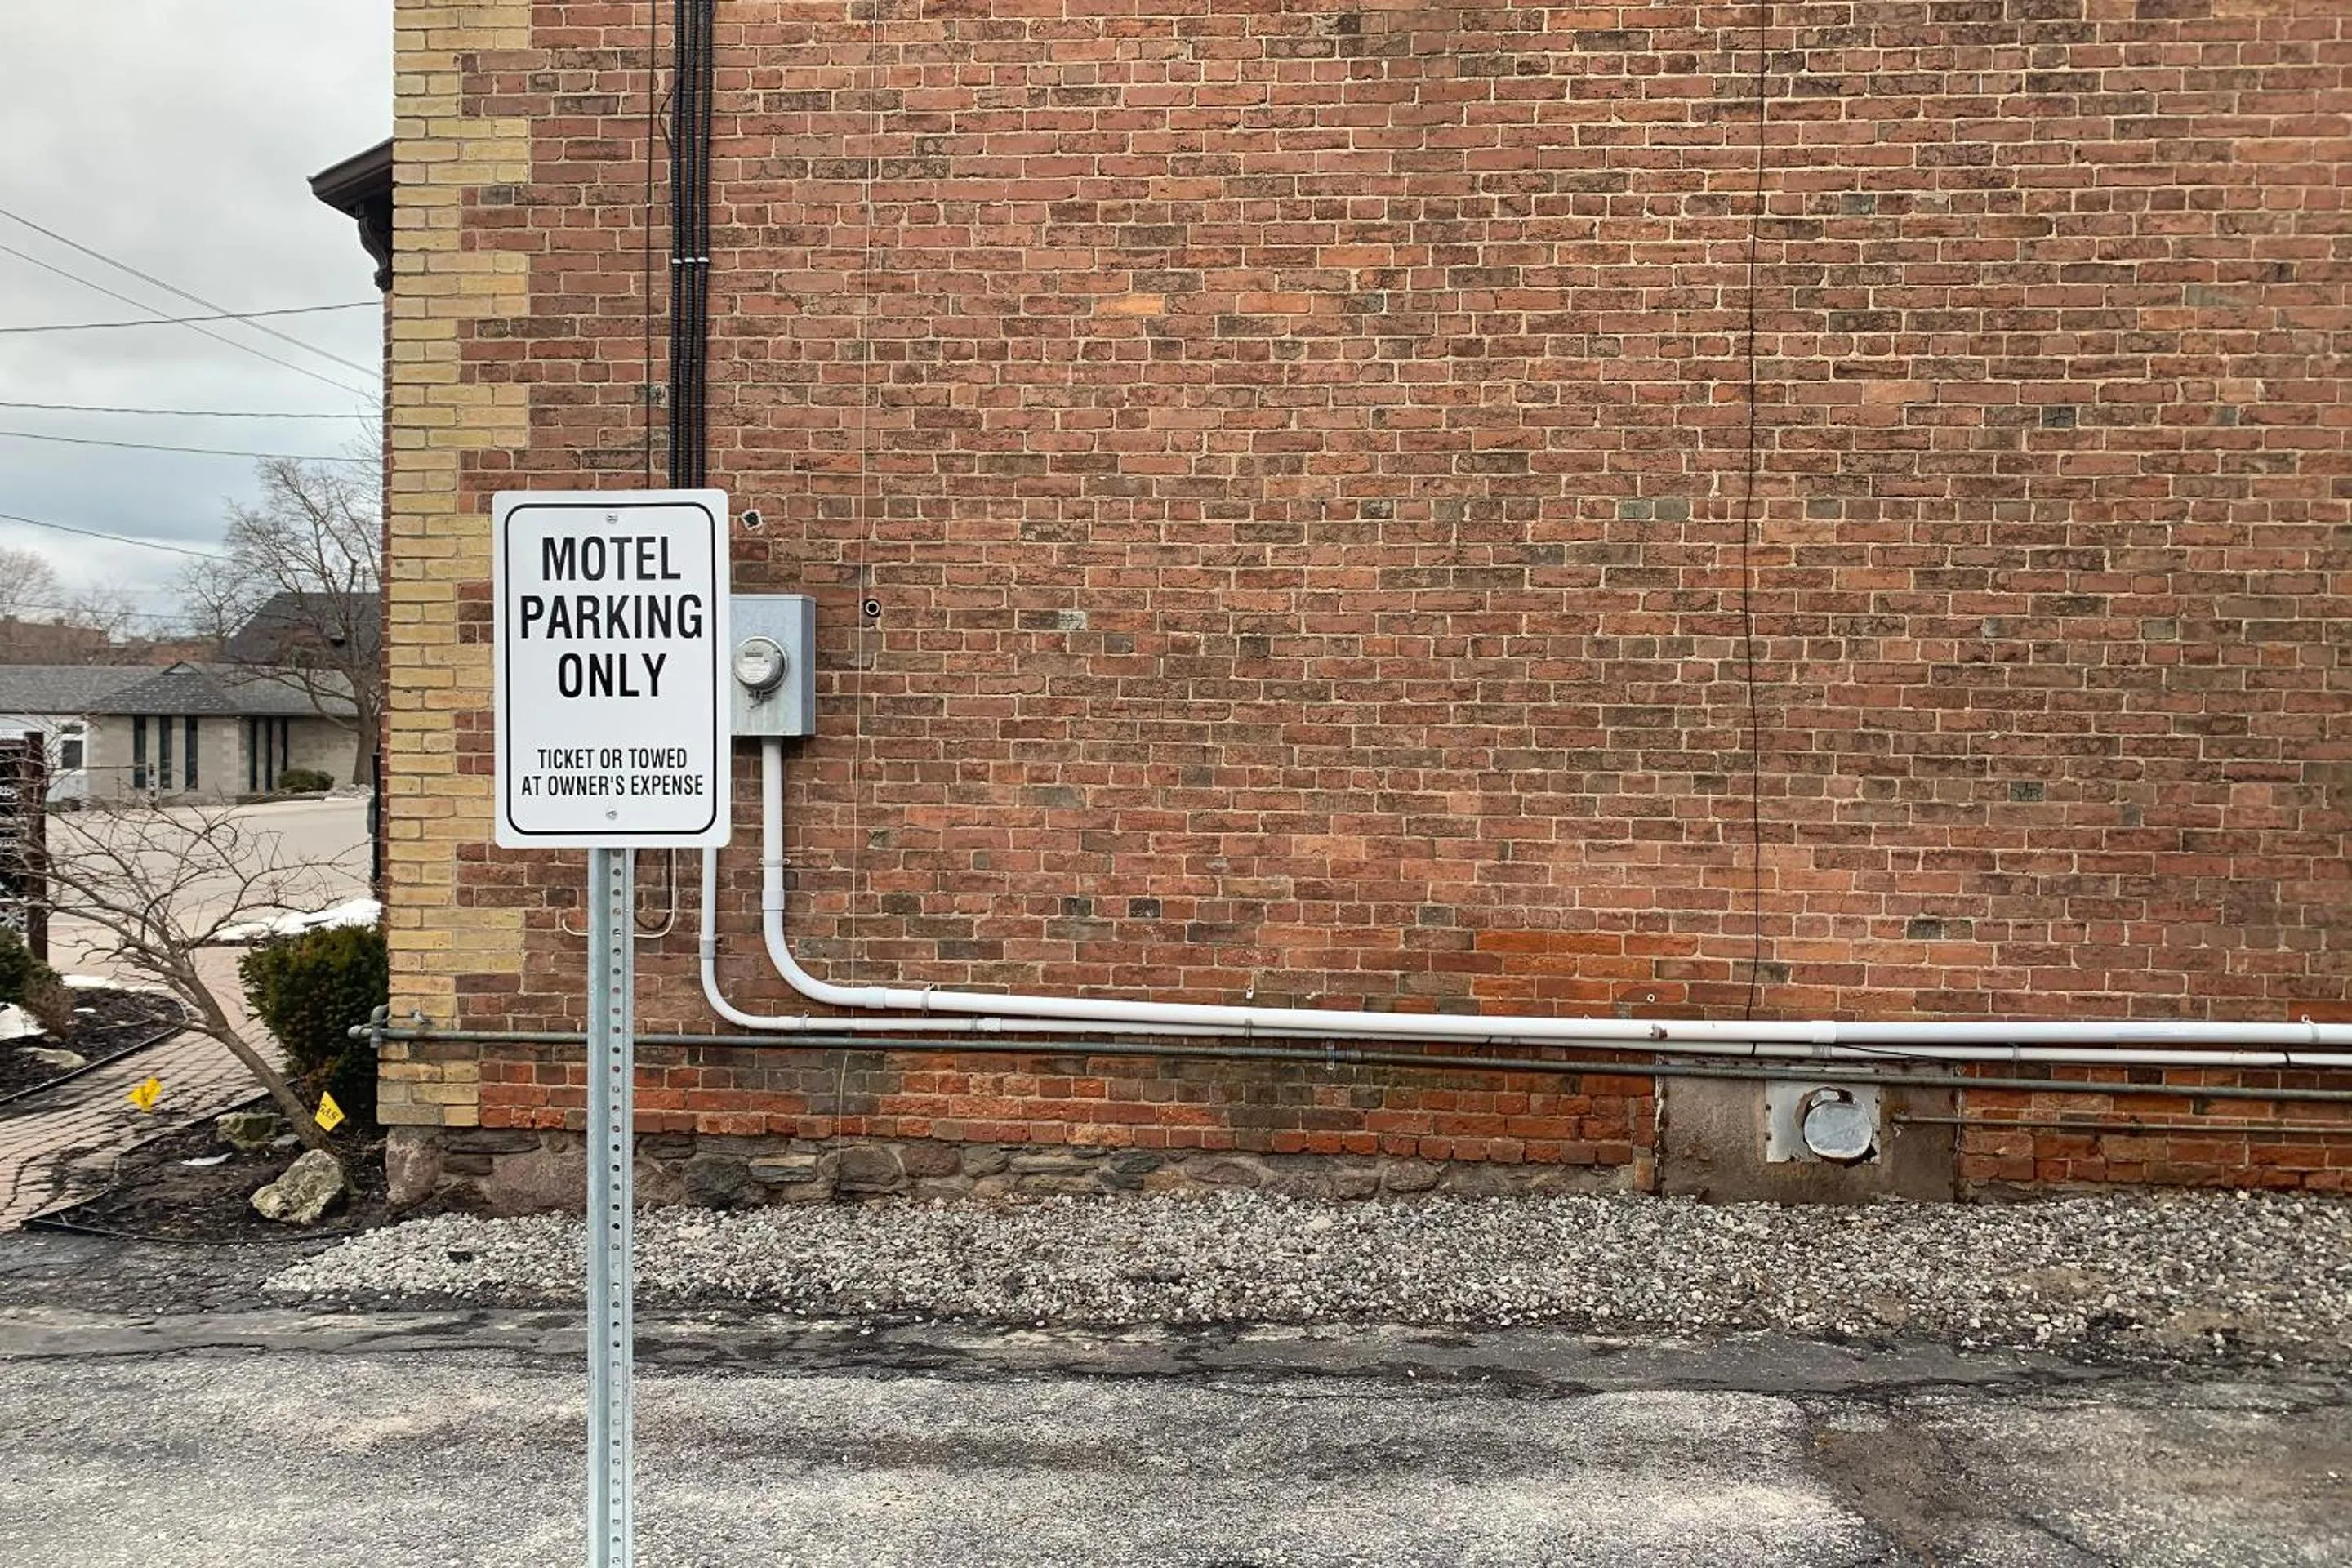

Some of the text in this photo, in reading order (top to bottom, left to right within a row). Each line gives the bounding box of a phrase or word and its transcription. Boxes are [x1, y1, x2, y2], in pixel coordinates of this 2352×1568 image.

[542, 536, 681, 581] MOTEL
[520, 594, 702, 639] PARKING
[558, 653, 667, 698] ONLY
[537, 748, 687, 769] TICKET OR TOWED
[521, 774, 703, 796] AT OWNER'S EXPENSE
[319, 1102, 339, 1120] GAS
